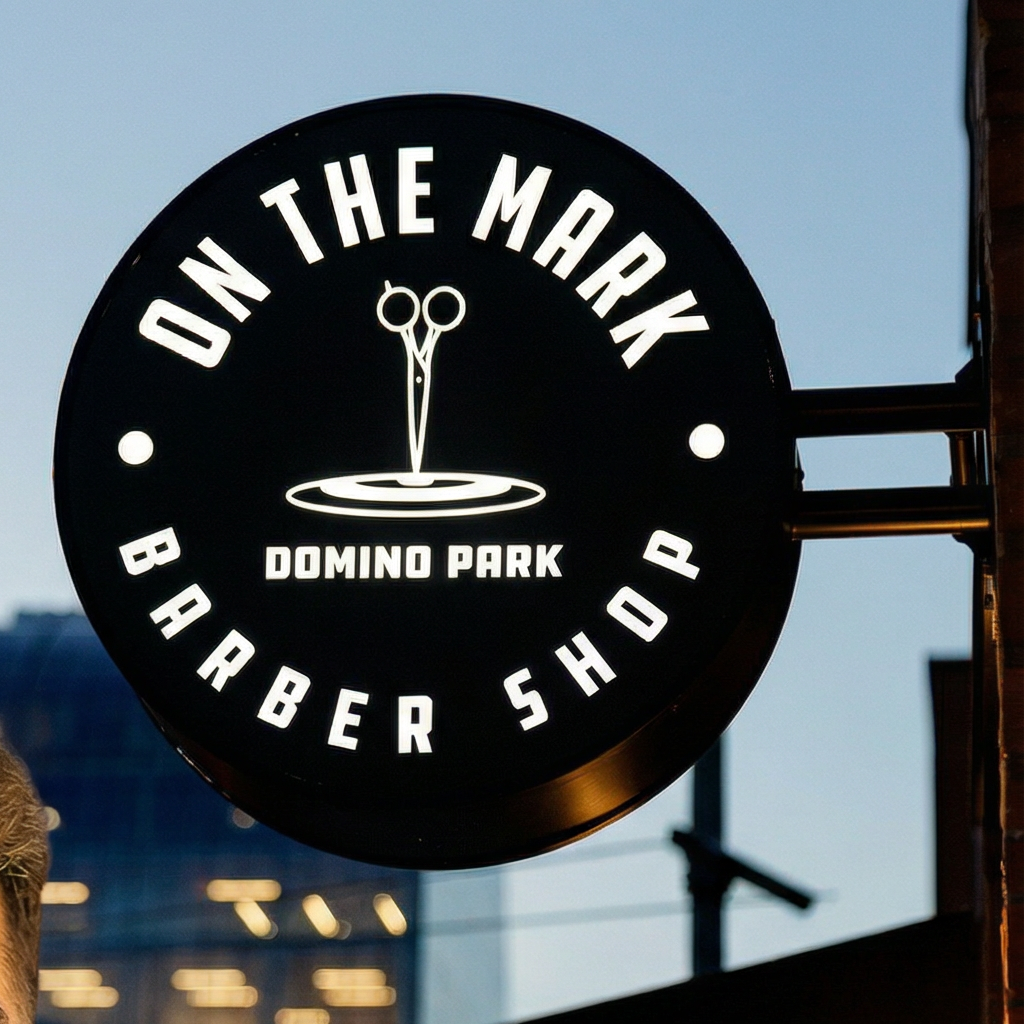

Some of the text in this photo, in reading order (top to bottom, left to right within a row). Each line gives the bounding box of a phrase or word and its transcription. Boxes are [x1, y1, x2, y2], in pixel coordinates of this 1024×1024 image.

[138, 146, 710, 370] ON THE MARK
[118, 526, 700, 754] BARBER SHOP
[265, 544, 564, 580] DOMINO PARK
